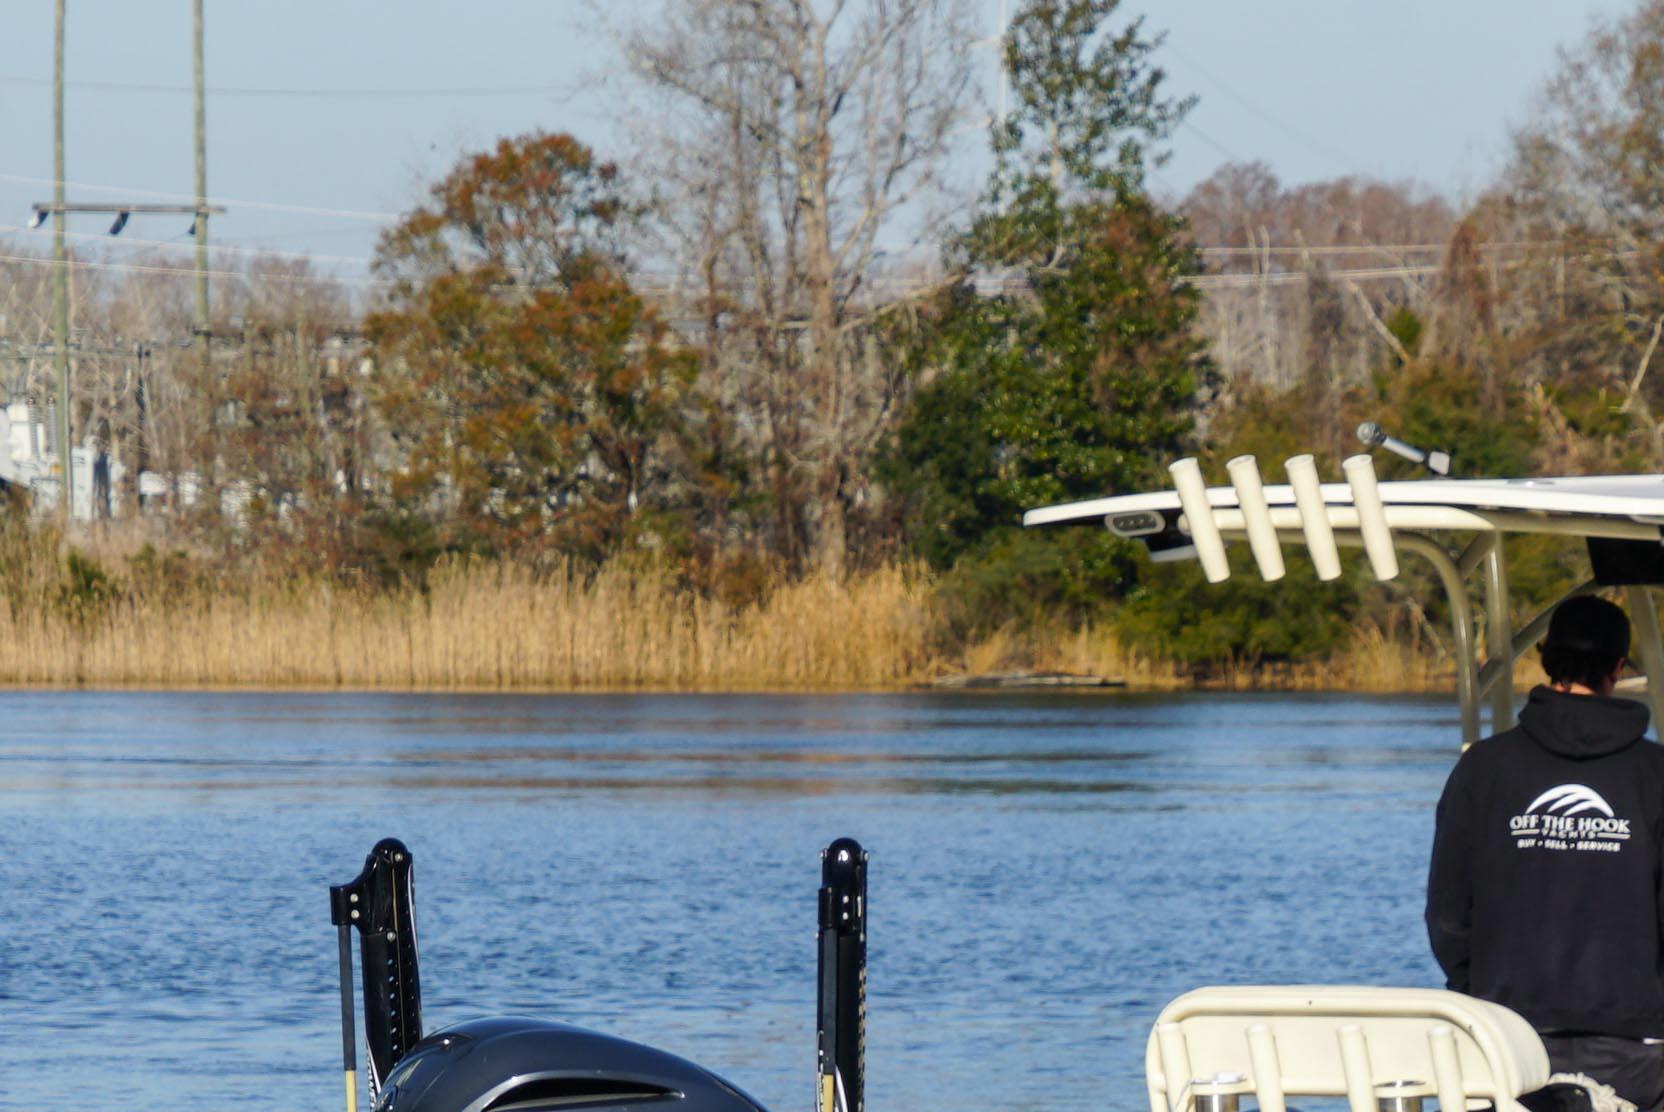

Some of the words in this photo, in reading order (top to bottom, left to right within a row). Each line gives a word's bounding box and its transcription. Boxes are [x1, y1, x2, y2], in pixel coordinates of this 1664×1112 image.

[1509, 815, 1539, 830] OFF
[1541, 815, 1574, 831] THE
[1578, 817, 1631, 833] HOOK
